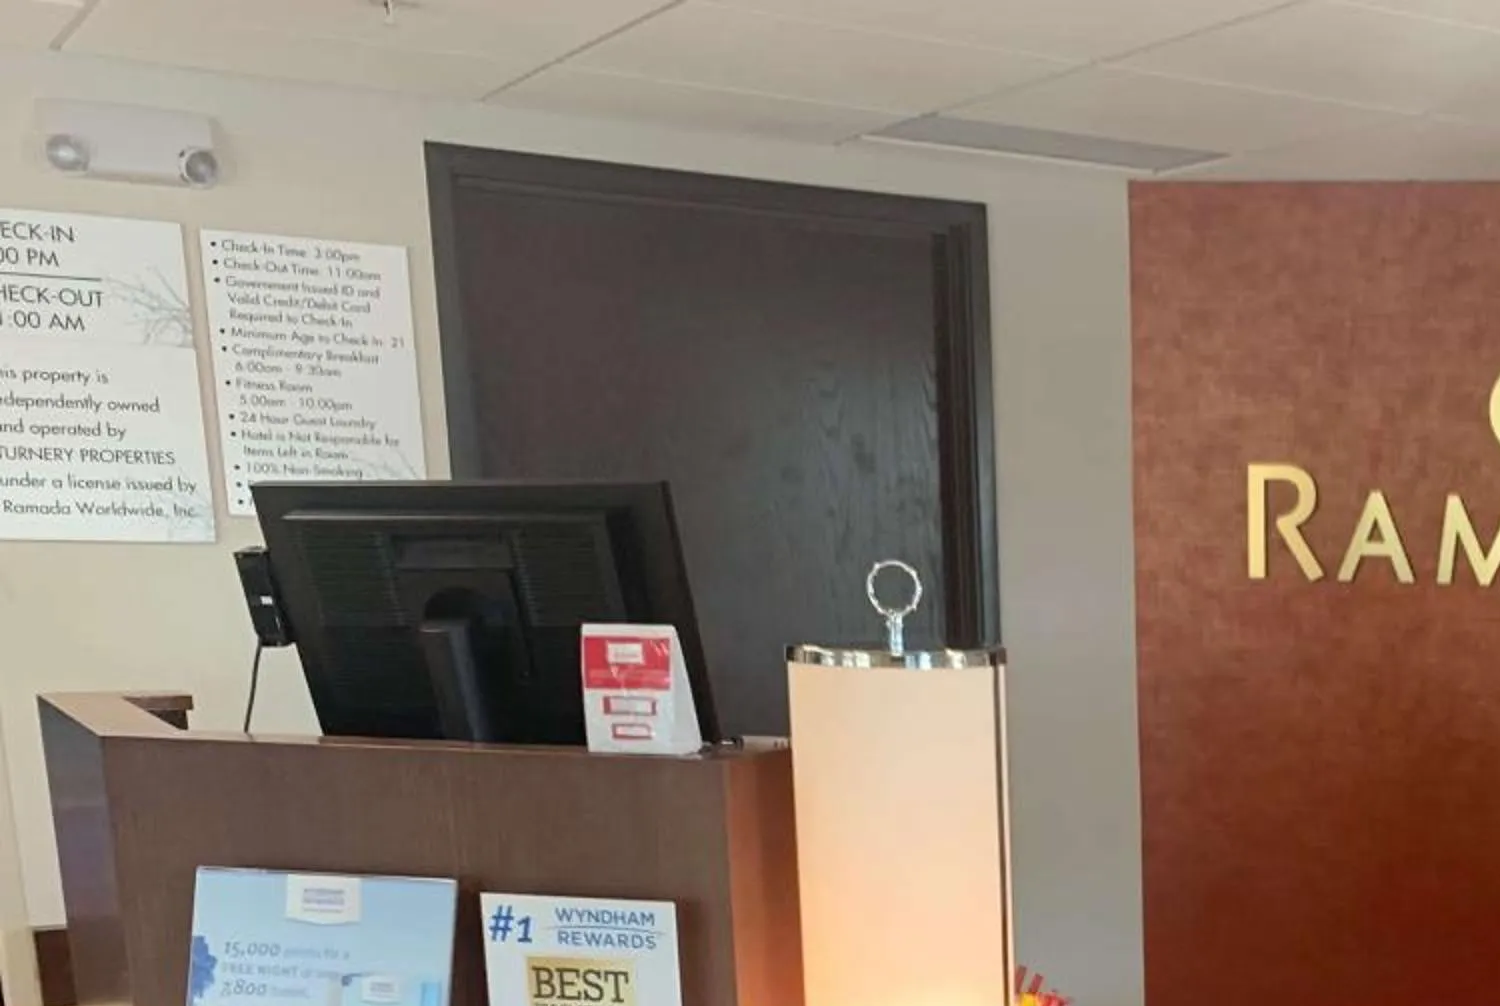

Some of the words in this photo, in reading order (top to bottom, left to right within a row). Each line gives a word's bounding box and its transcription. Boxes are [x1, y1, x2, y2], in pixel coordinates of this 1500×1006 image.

[27, 247, 59, 267] PM
[50, 312, 85, 331] AM
[22, 368, 91, 387] property
[96, 369, 109, 385] is
[0, 389, 102, 413] dependently
[107, 395, 160, 413] owned
[29, 420, 101, 439] operated
[106, 420, 127, 442] by
[80, 448, 176, 465] PROPERTIES
[0, 470, 46, 488] under
[52, 478, 63, 490] a
[67, 471, 121, 491] license
[125, 474, 173, 492] issued
[178, 475, 197, 498] by
[3, 498, 71, 516] Ramada
[488, 904, 533, 943] #1
[554, 907, 656, 926] WYNDHAM
[557, 931, 657, 950] REWARDS
[531, 965, 629, 1003] BEST
